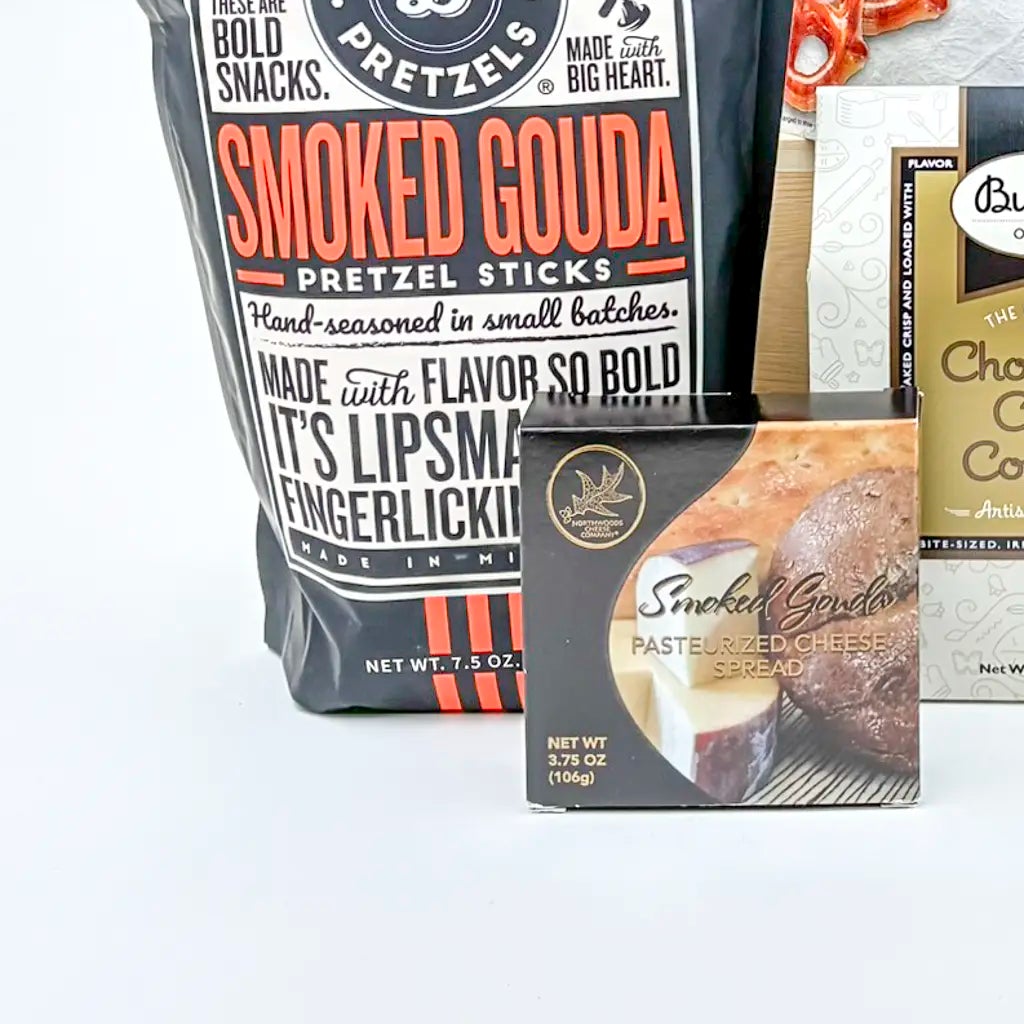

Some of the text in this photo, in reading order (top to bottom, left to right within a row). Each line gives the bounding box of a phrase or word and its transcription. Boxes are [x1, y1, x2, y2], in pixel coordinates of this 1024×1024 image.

[212, 17, 283, 59] BOLD
[566, 35, 663, 64] MADE with
[337, 19, 539, 98] PRETZELS
[217, 59, 331, 103] SNACKS.
[566, 59, 671, 94] BIG HEART.
[907, 158, 953, 170] FLAVOR
[216, 109, 686, 262] SMOKED GOUDA
[902, 182, 913, 219] WITH
[902, 221, 913, 276] LOADED
[298, 258, 612, 293] PRETZEL STICKS
[902, 281, 913, 310] AND
[247, 291, 679, 338] Hand-seasoned in small batches.
[902, 312, 913, 348] CRISP
[983, 305, 1018, 330] THE
[257, 342, 681, 408] MADE with FLAVOR SO BOLD
[268, 402, 339, 483] IT'S
[299, 540, 372, 569] MADE
[407, 553, 442, 569] IN
[638, 573, 896, 632] Smoked Gouda
[631, 634, 886, 656] PASTEURIZED CHEESE
[365, 654, 521, 674] NET WT. 7.5 OZ.
[713, 659, 804, 679] SPREAD
[979, 663, 1006, 674] Net
[547, 736, 607, 750] NET WT
[547, 753, 607, 767] 3.75 OZ
[547, 770, 595, 786] (106g)
